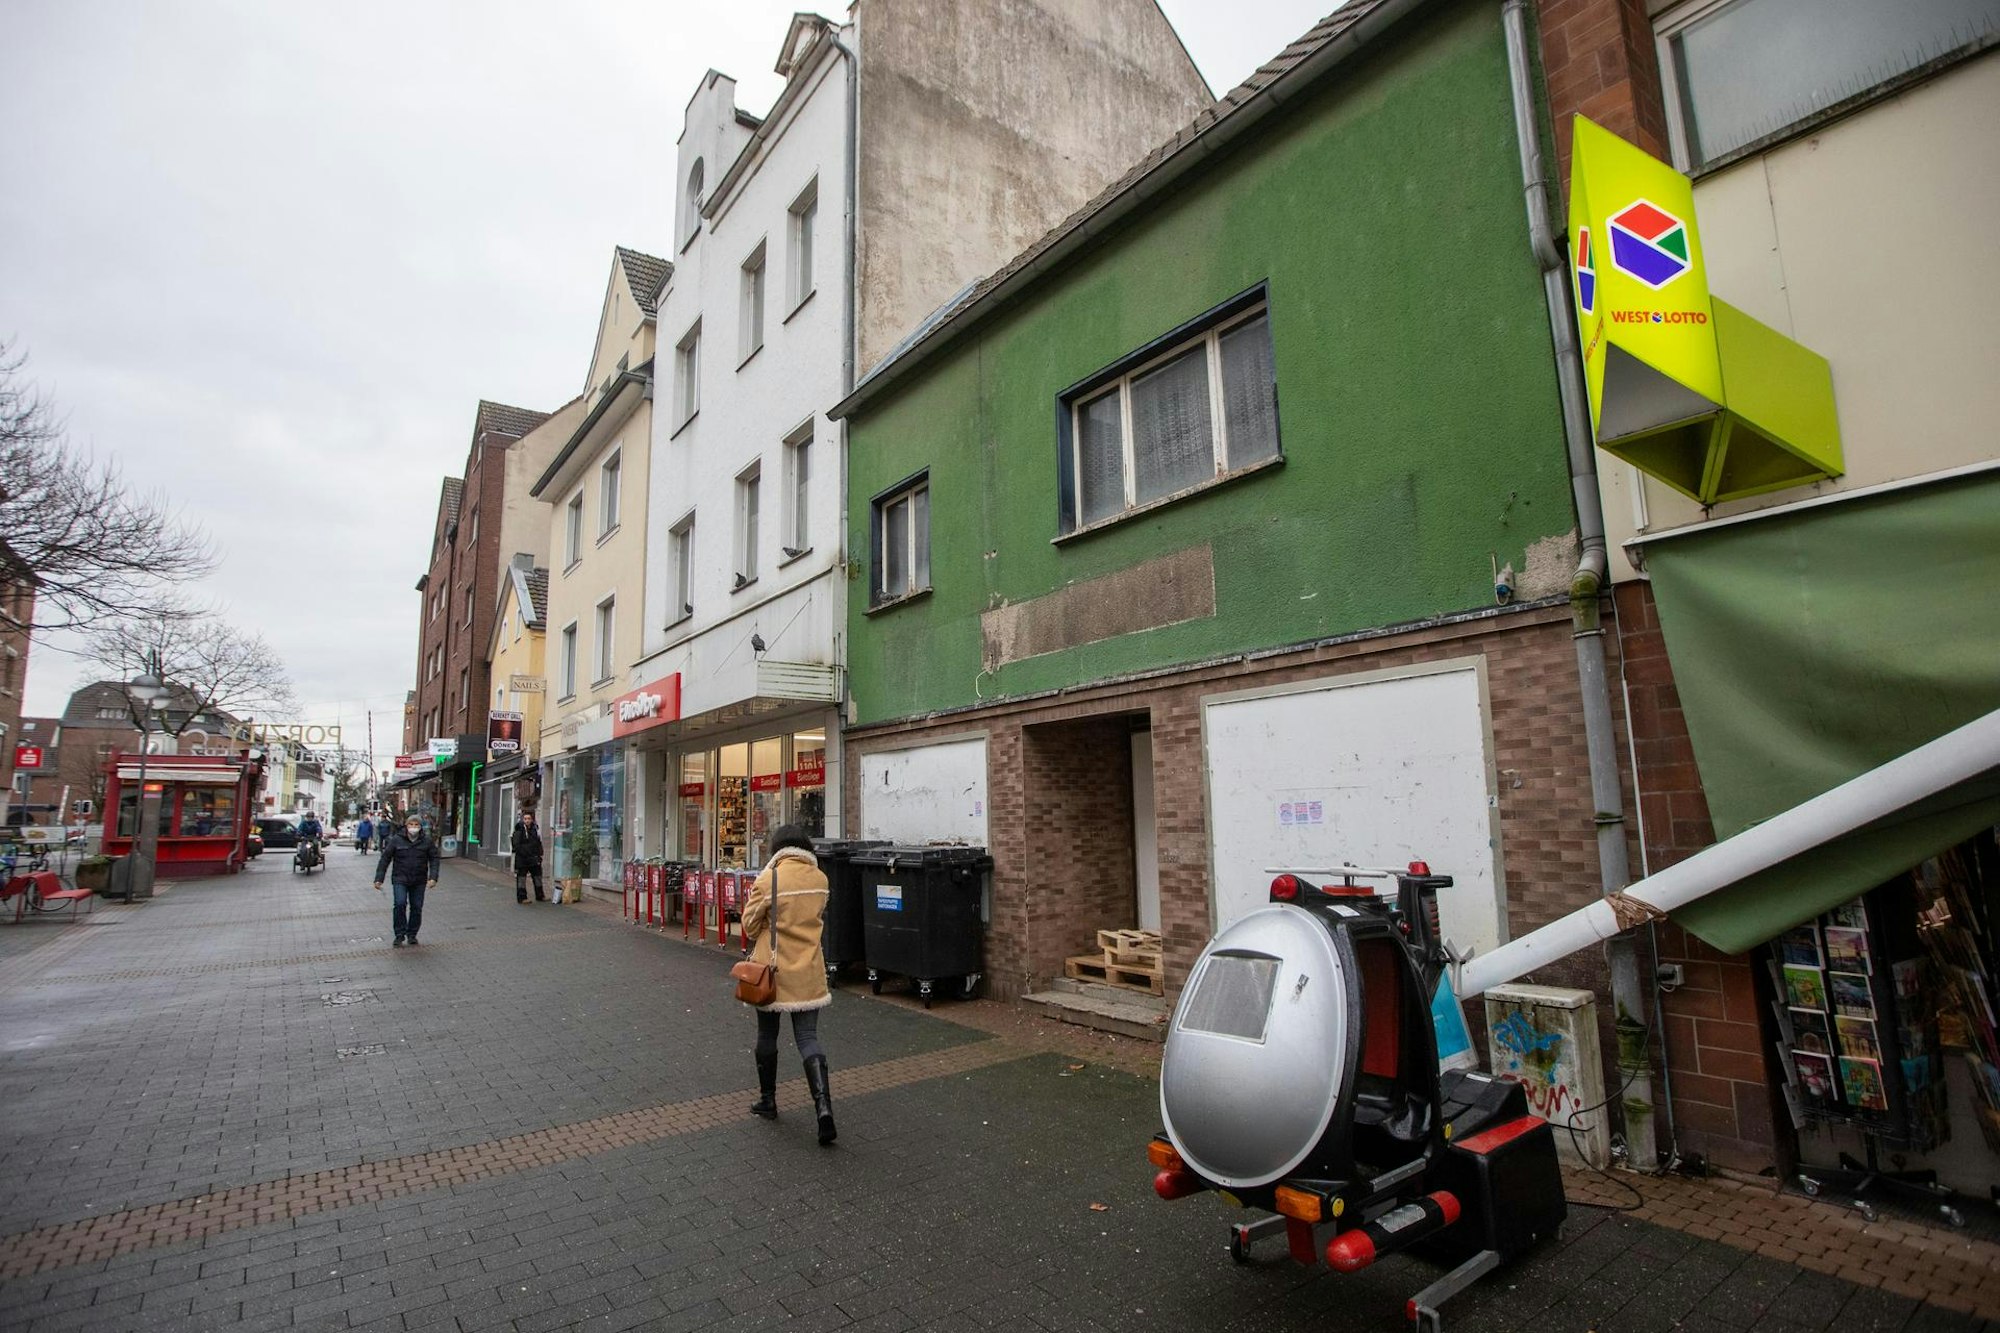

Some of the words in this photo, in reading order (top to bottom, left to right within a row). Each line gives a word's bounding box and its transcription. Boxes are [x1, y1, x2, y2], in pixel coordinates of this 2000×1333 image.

[1611, 310, 1650, 323] WEST
[1664, 311, 1708, 325] LOTTO
[513, 681, 540, 689] NAILS
